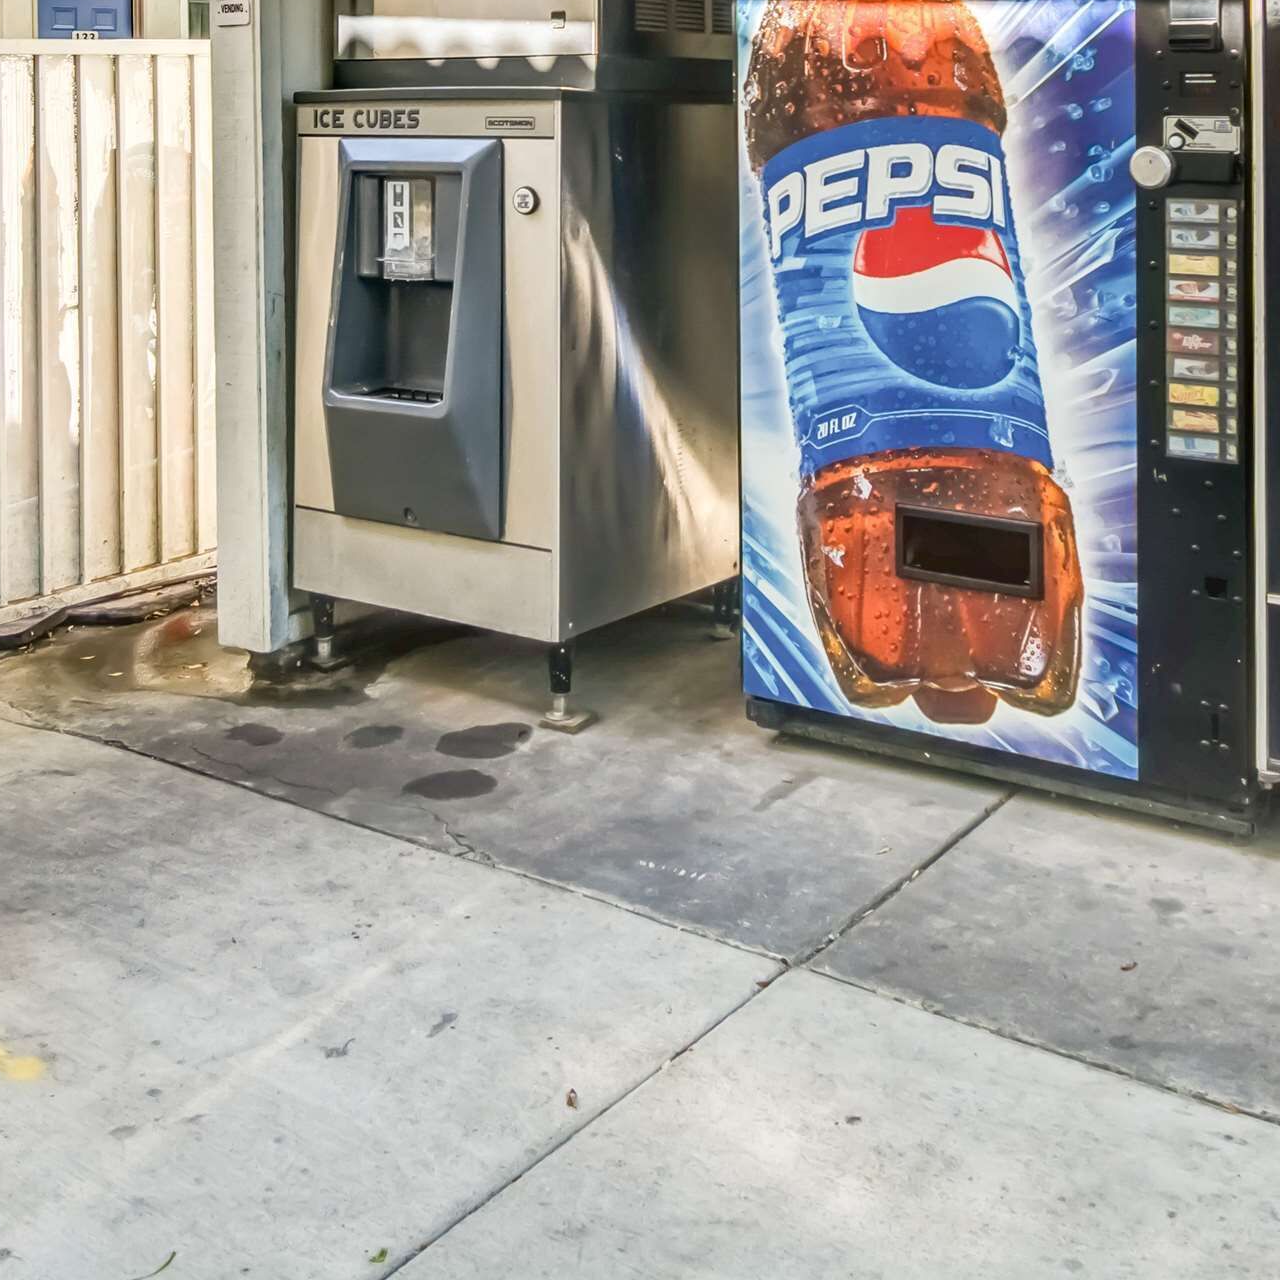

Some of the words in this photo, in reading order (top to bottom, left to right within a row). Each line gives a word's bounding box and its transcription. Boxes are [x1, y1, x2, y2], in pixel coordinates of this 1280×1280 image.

[220, 3, 244, 14] VENDING
[312, 108, 345, 129] ICE
[352, 108, 421, 130] CUBES
[487, 119, 533, 128] SCOTSMAN
[767, 142, 1006, 261] PEPSI
[817, 422, 829, 440] 20
[830, 418, 840, 434] FL
[841, 412, 857, 430] OZ
